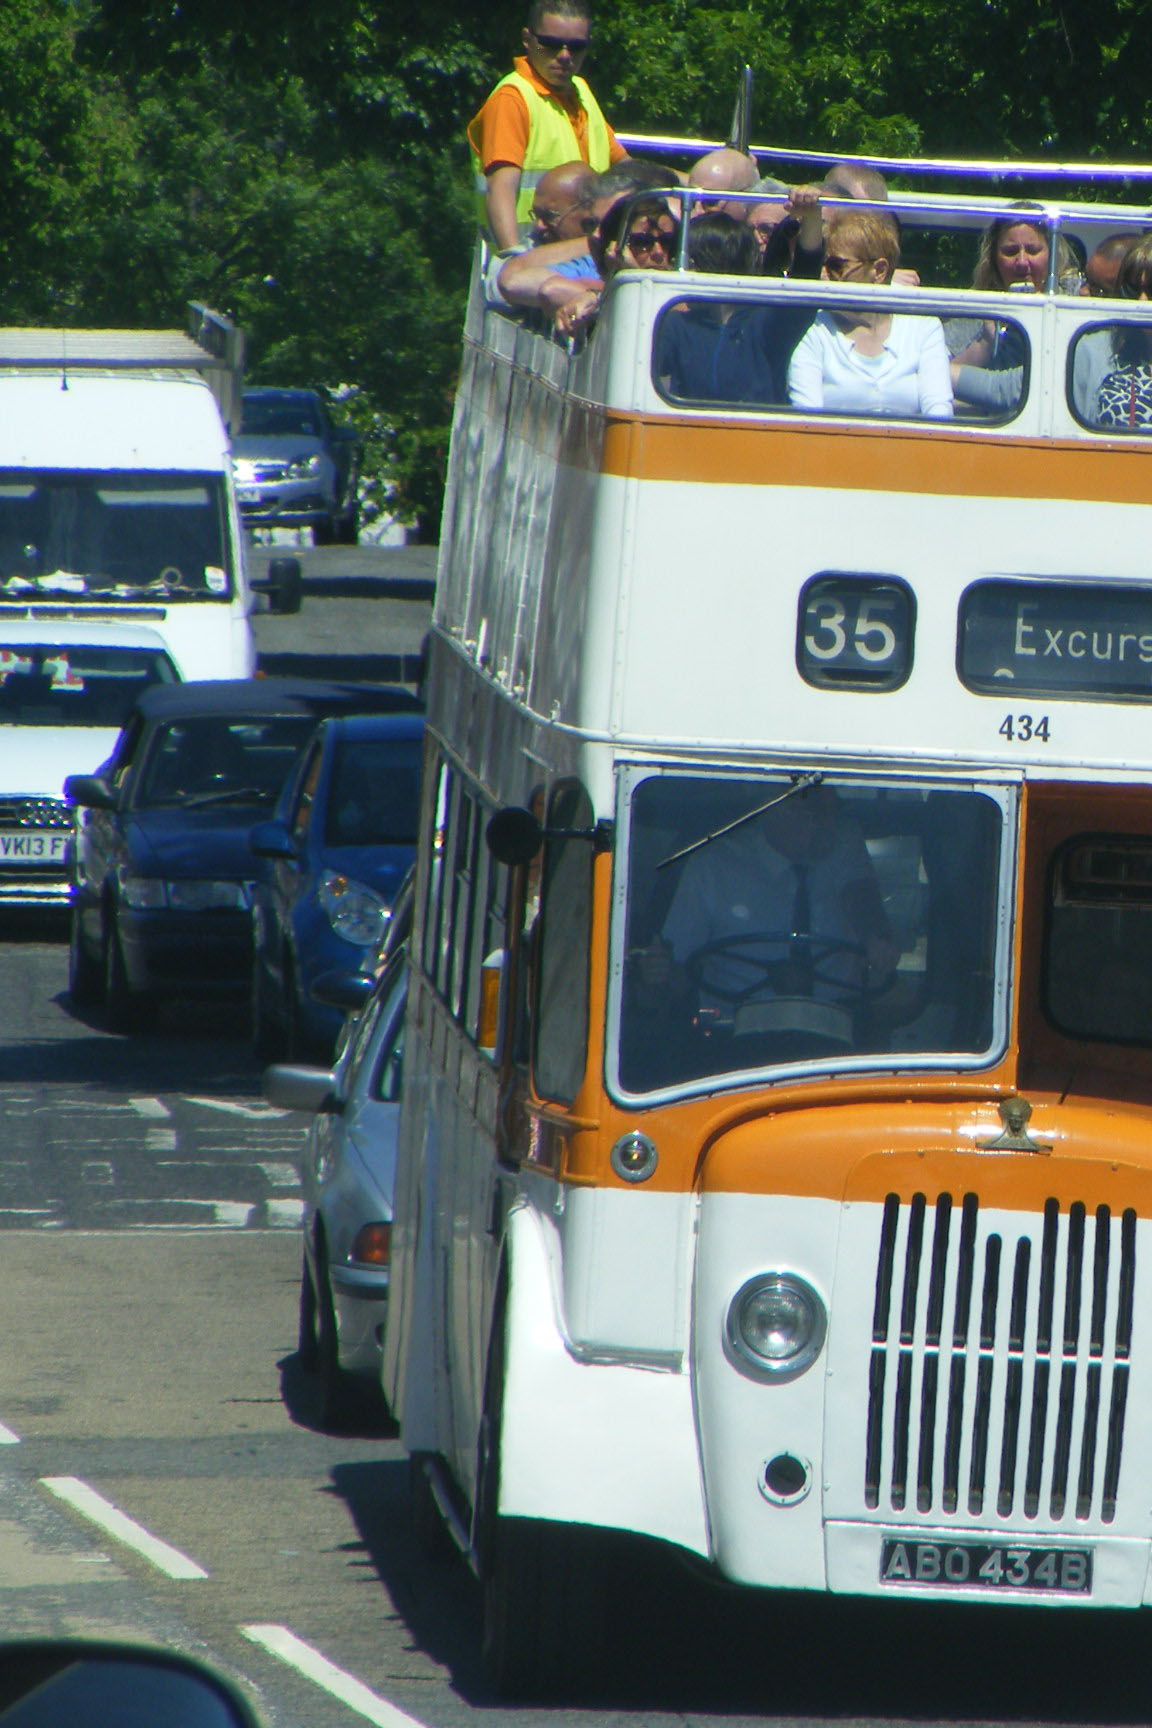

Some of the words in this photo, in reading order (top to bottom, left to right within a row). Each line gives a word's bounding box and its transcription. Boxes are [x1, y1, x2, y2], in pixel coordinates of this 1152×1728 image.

[805, 596, 896, 662] 35
[998, 714, 1051, 742] 434
[978, 1549, 1089, 1590] 434B
